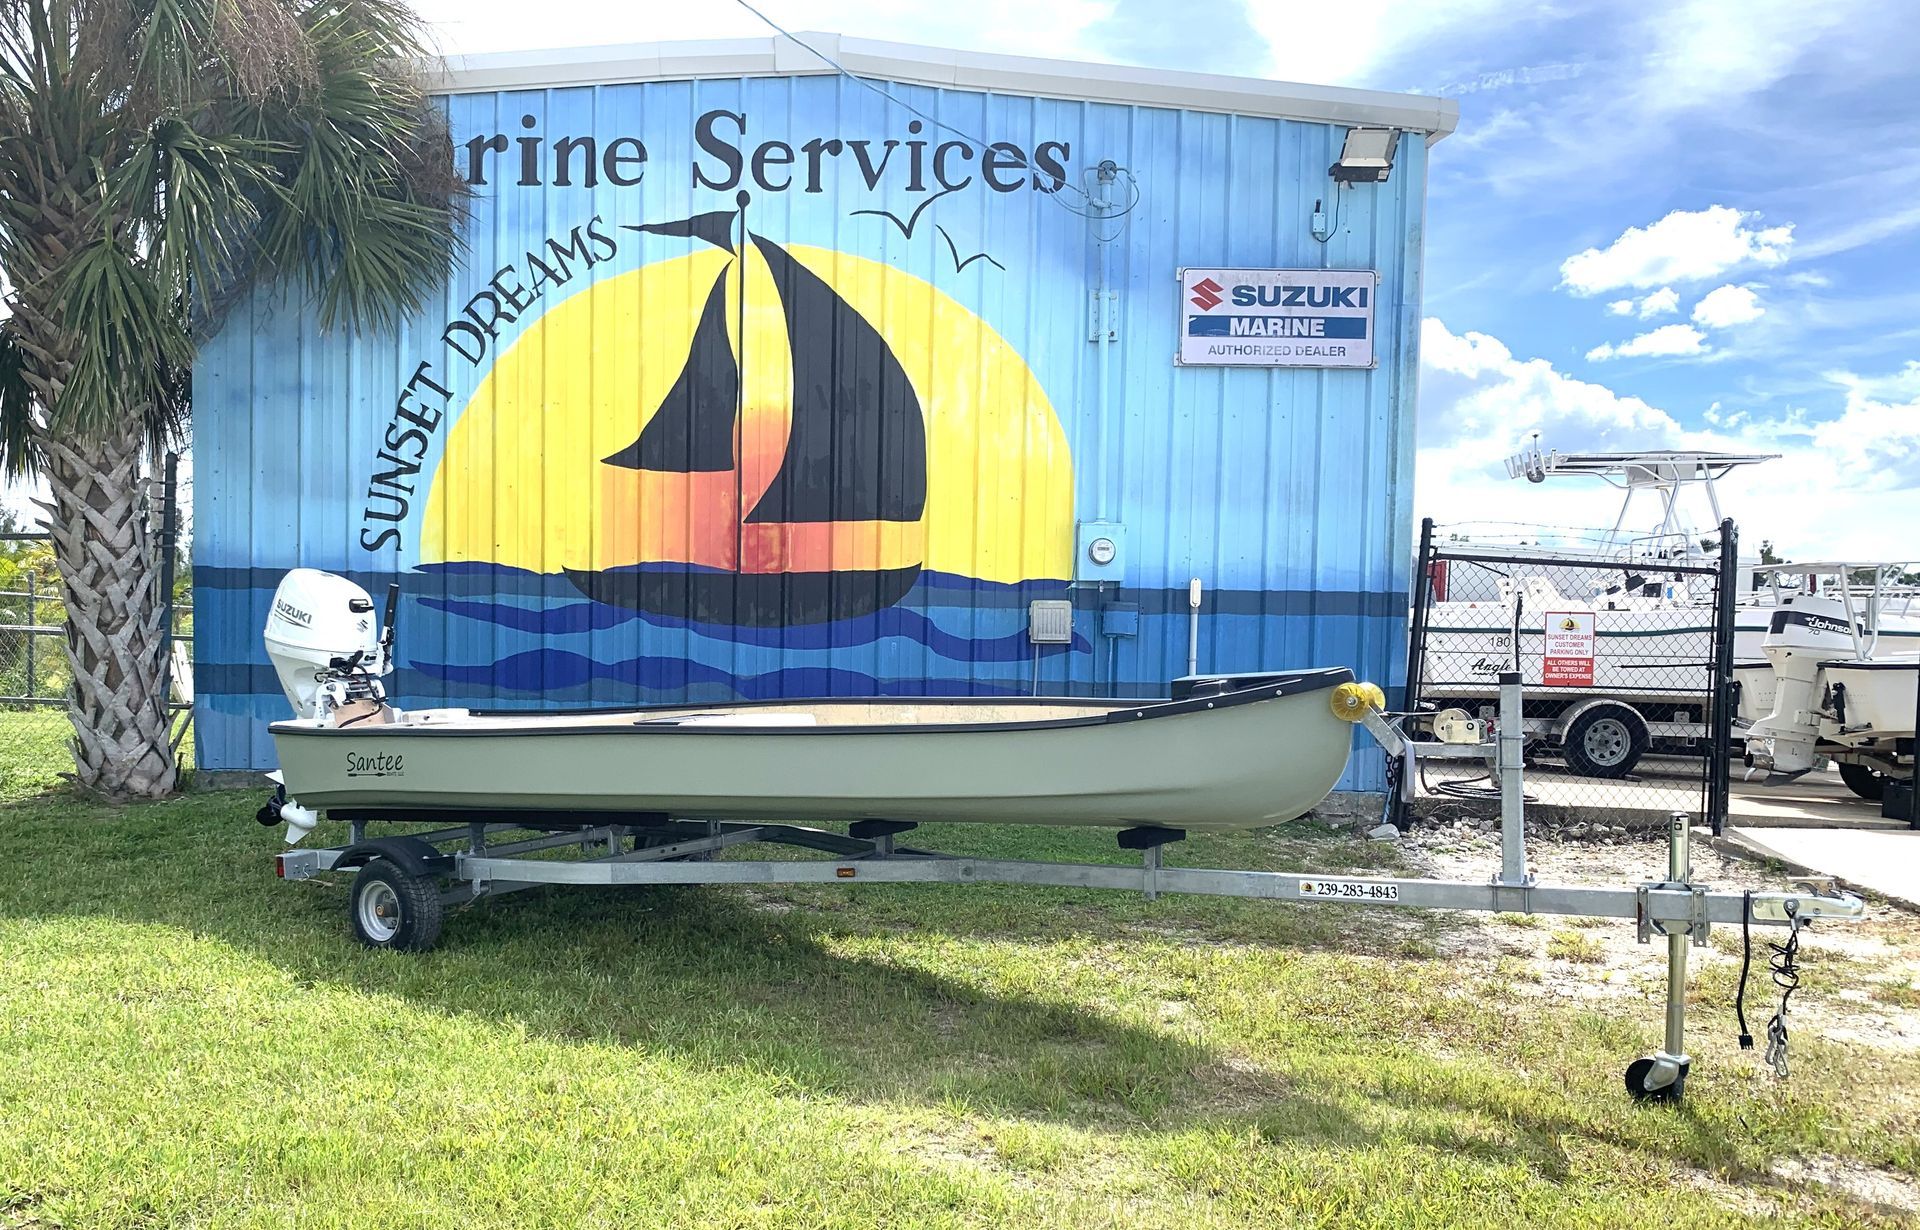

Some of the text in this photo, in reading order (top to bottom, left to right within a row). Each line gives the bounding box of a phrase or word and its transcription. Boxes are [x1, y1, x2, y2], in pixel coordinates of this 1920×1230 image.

[465, 109, 1070, 194] rine Services
[1231, 285, 1368, 308] SUZUKI
[1229, 317, 1325, 337] MARINE
[1208, 344, 1346, 357] AUTHORIZED DEALER
[360, 214, 617, 552] SUNSET DREAMS
[276, 599, 312, 624] SUZUKI
[1490, 636, 1511, 648] 180
[346, 751, 404, 772] Santee
[1317, 883, 1398, 899] 239-283-4843
